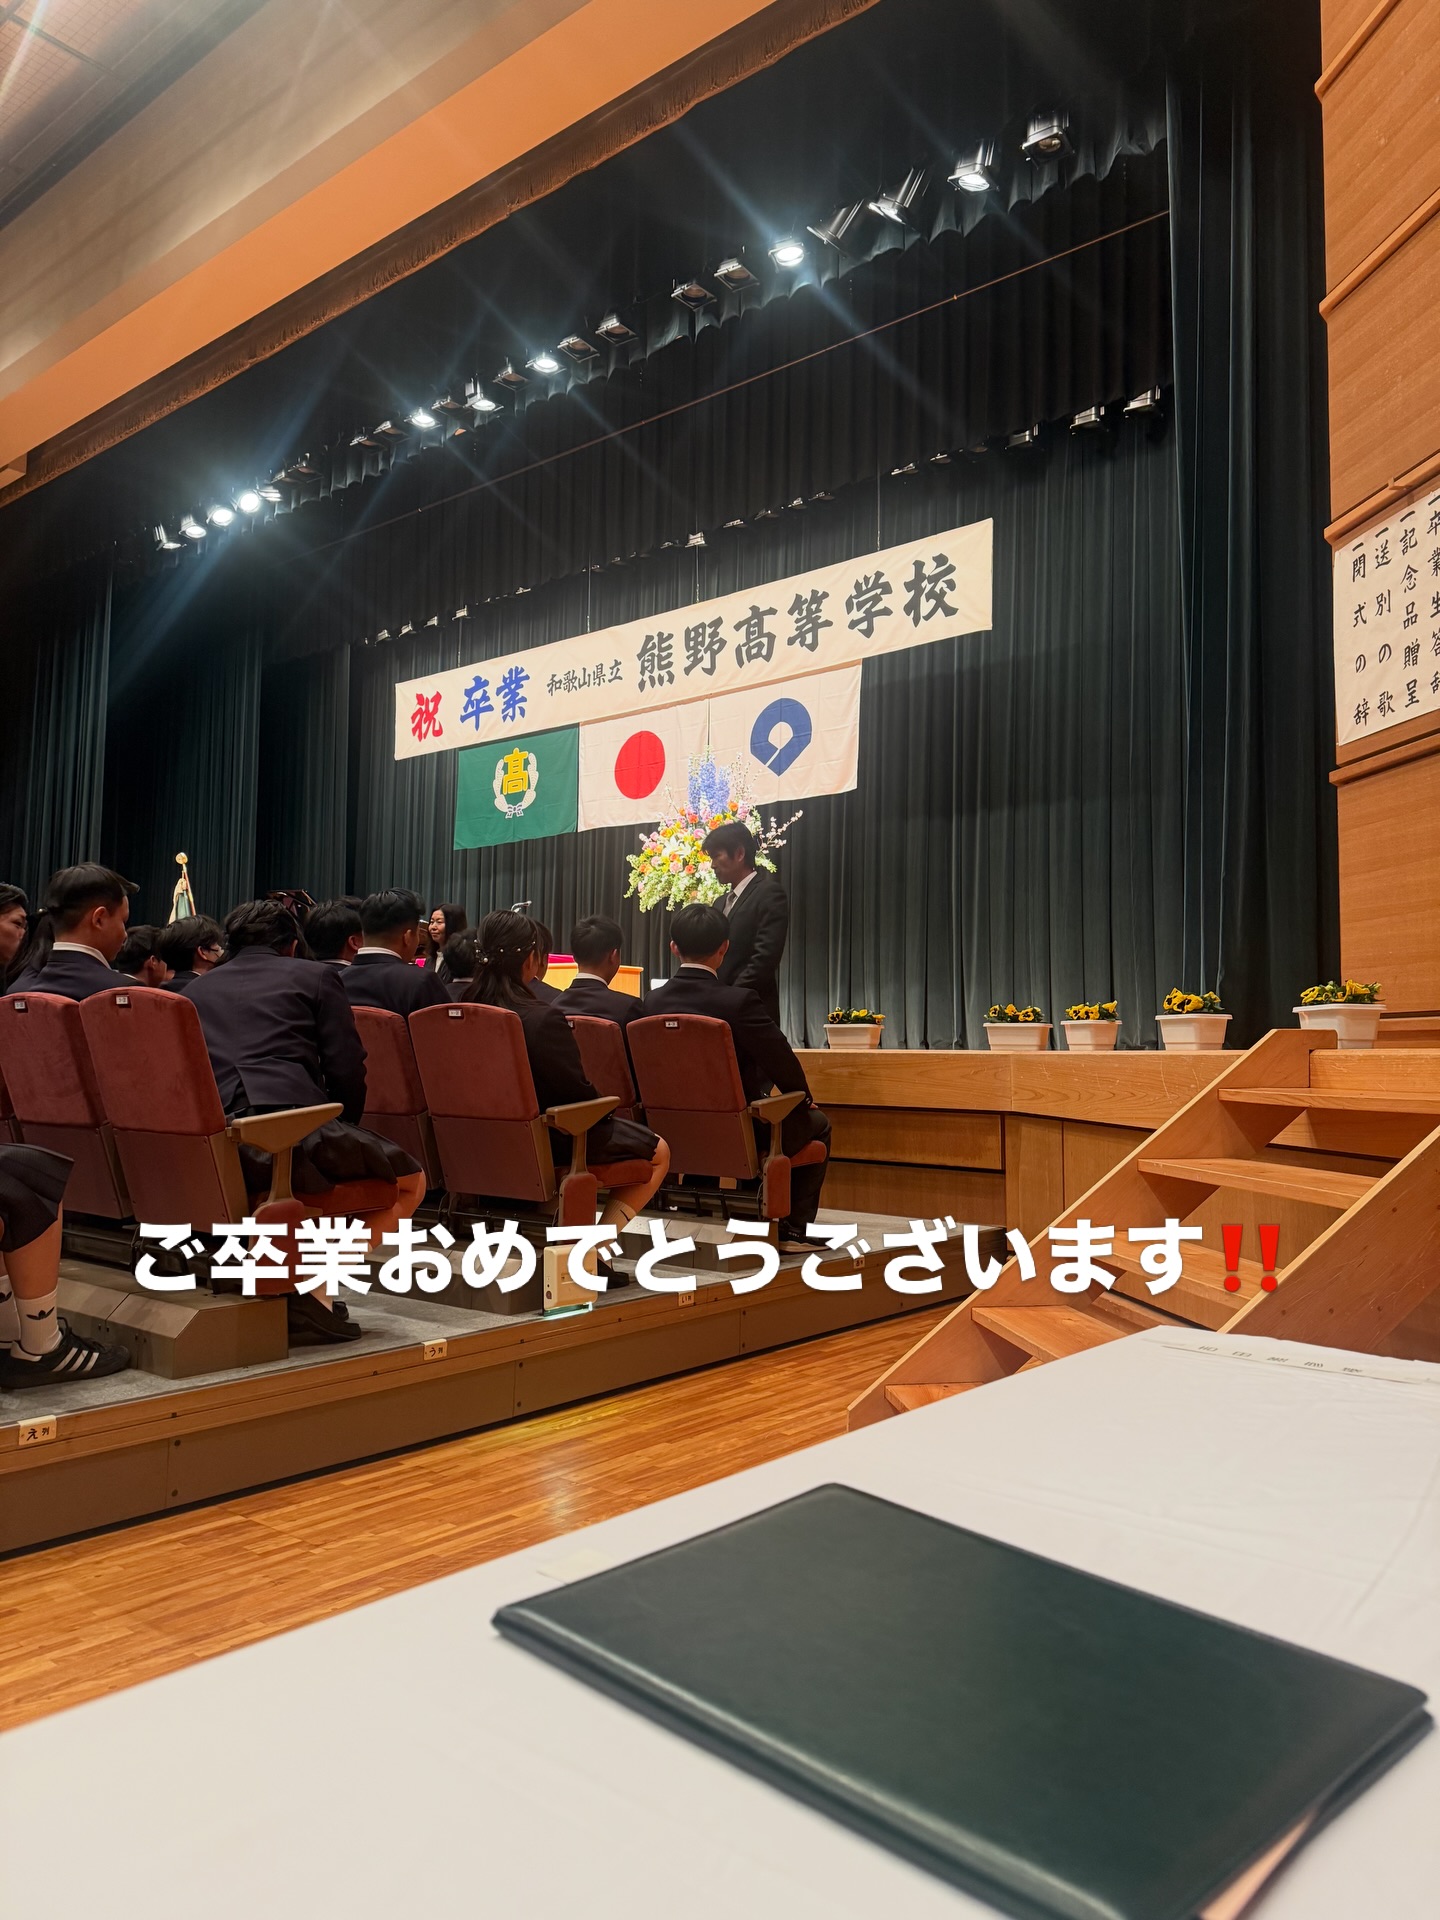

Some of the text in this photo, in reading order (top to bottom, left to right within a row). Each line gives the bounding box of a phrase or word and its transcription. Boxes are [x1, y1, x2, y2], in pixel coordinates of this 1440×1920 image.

[410, 690, 443, 742] 祝
[459, 665, 530, 731] 卒業
[546, 658, 623, 696] 和歌山県立
